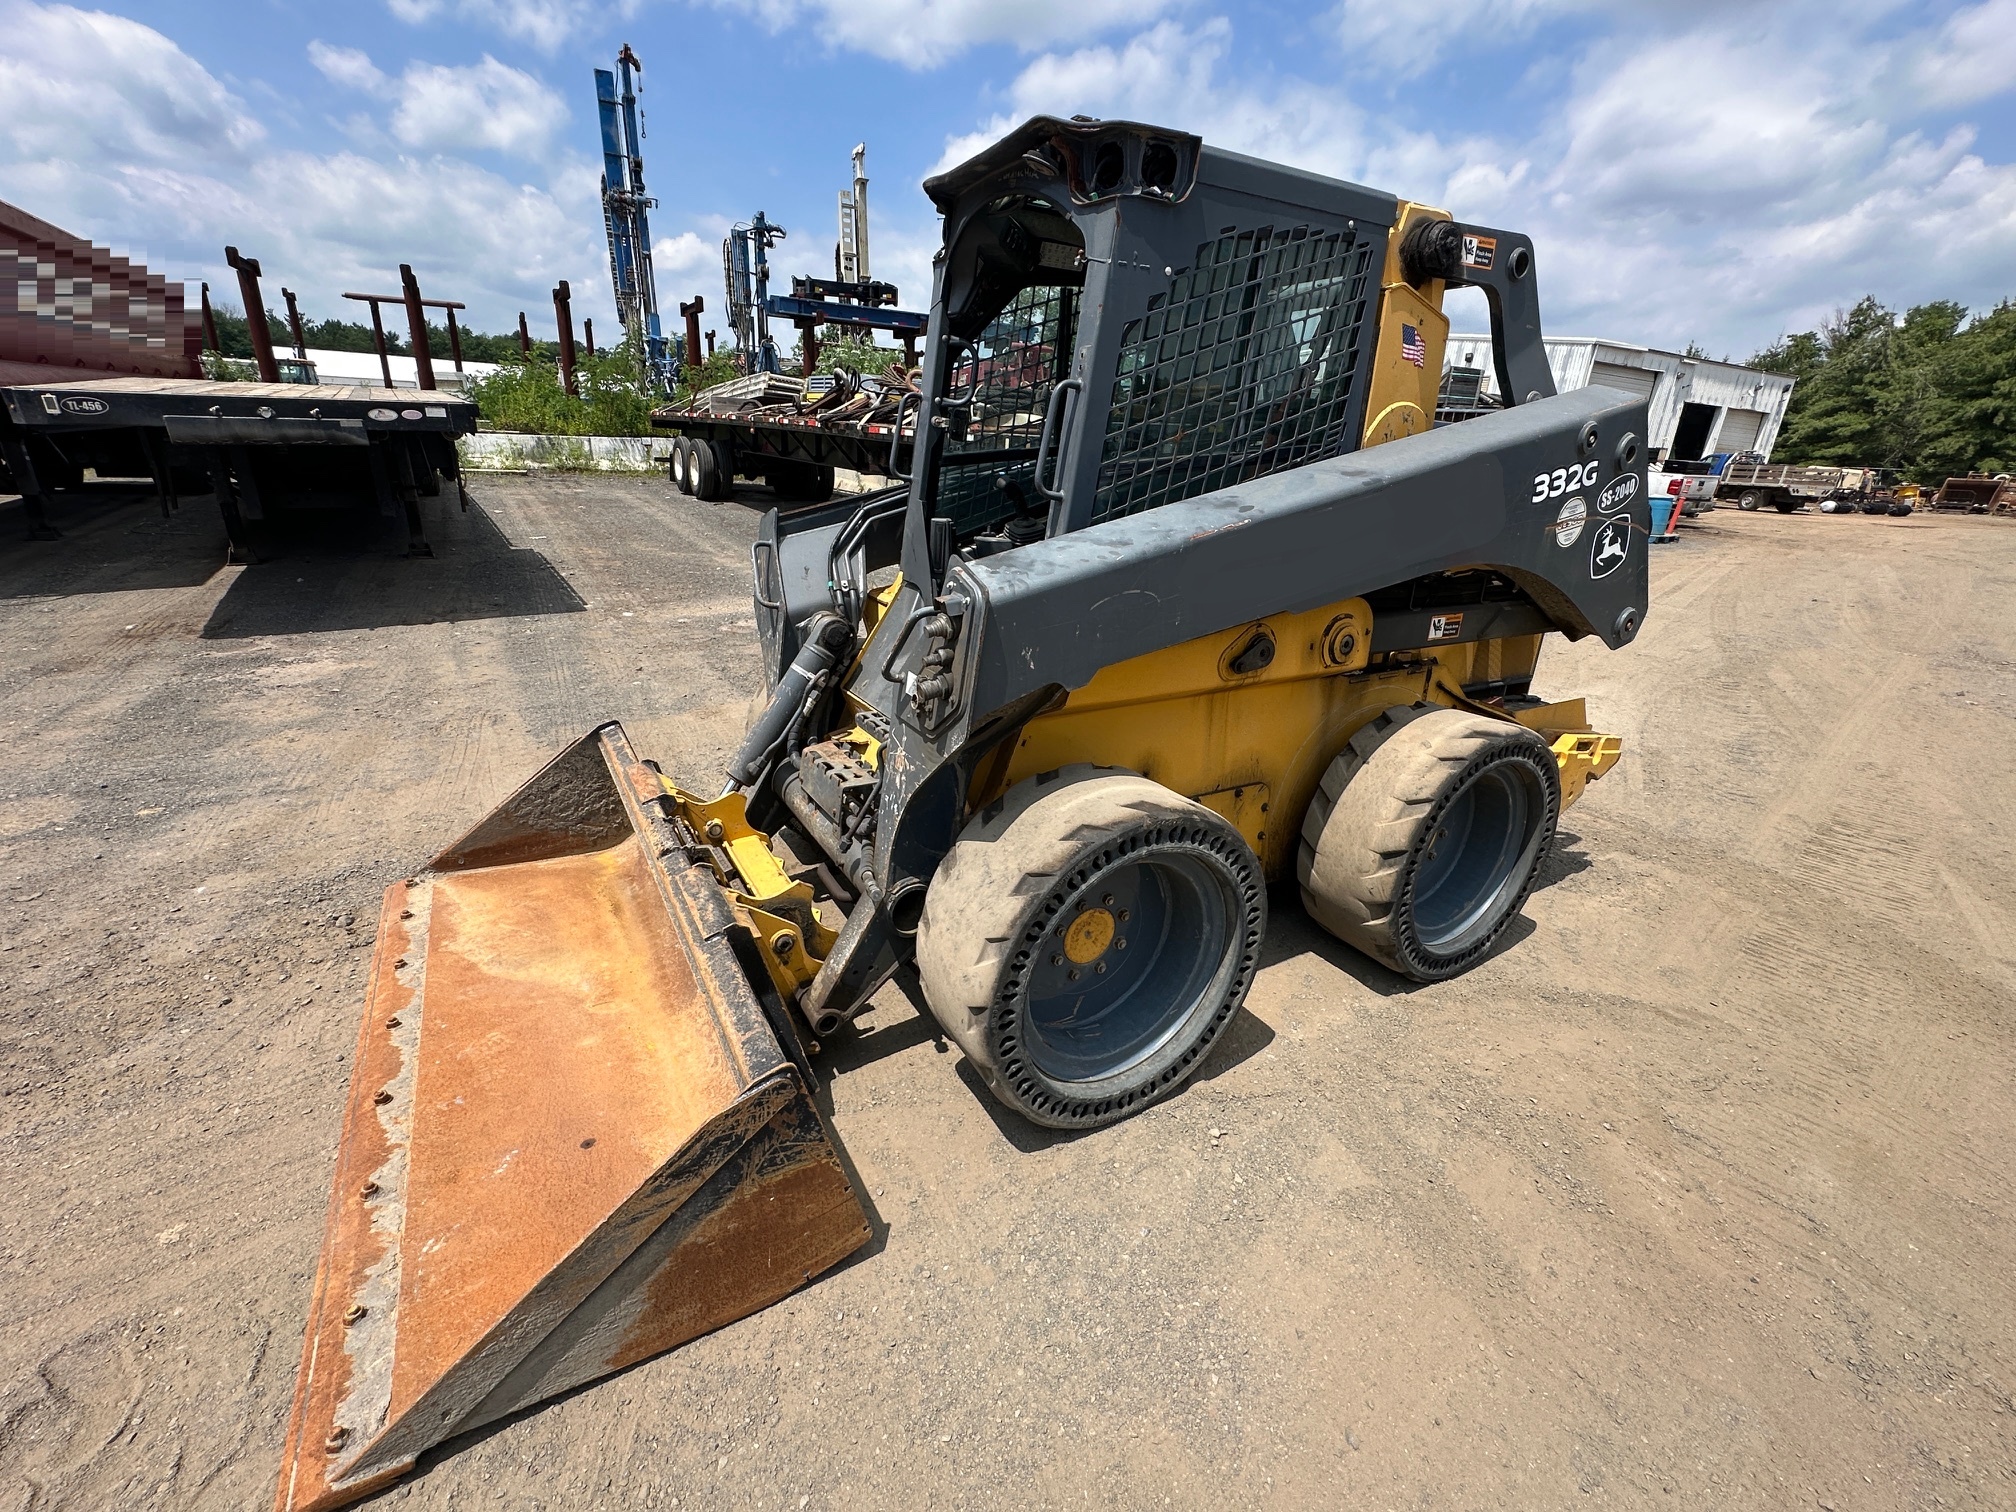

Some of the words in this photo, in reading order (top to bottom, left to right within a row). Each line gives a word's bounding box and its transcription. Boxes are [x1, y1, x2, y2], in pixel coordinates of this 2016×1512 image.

[66, 400, 103, 411] TL-456
[1531, 460, 1599, 503] 332G
[1601, 478, 1636, 508] SS-2040
